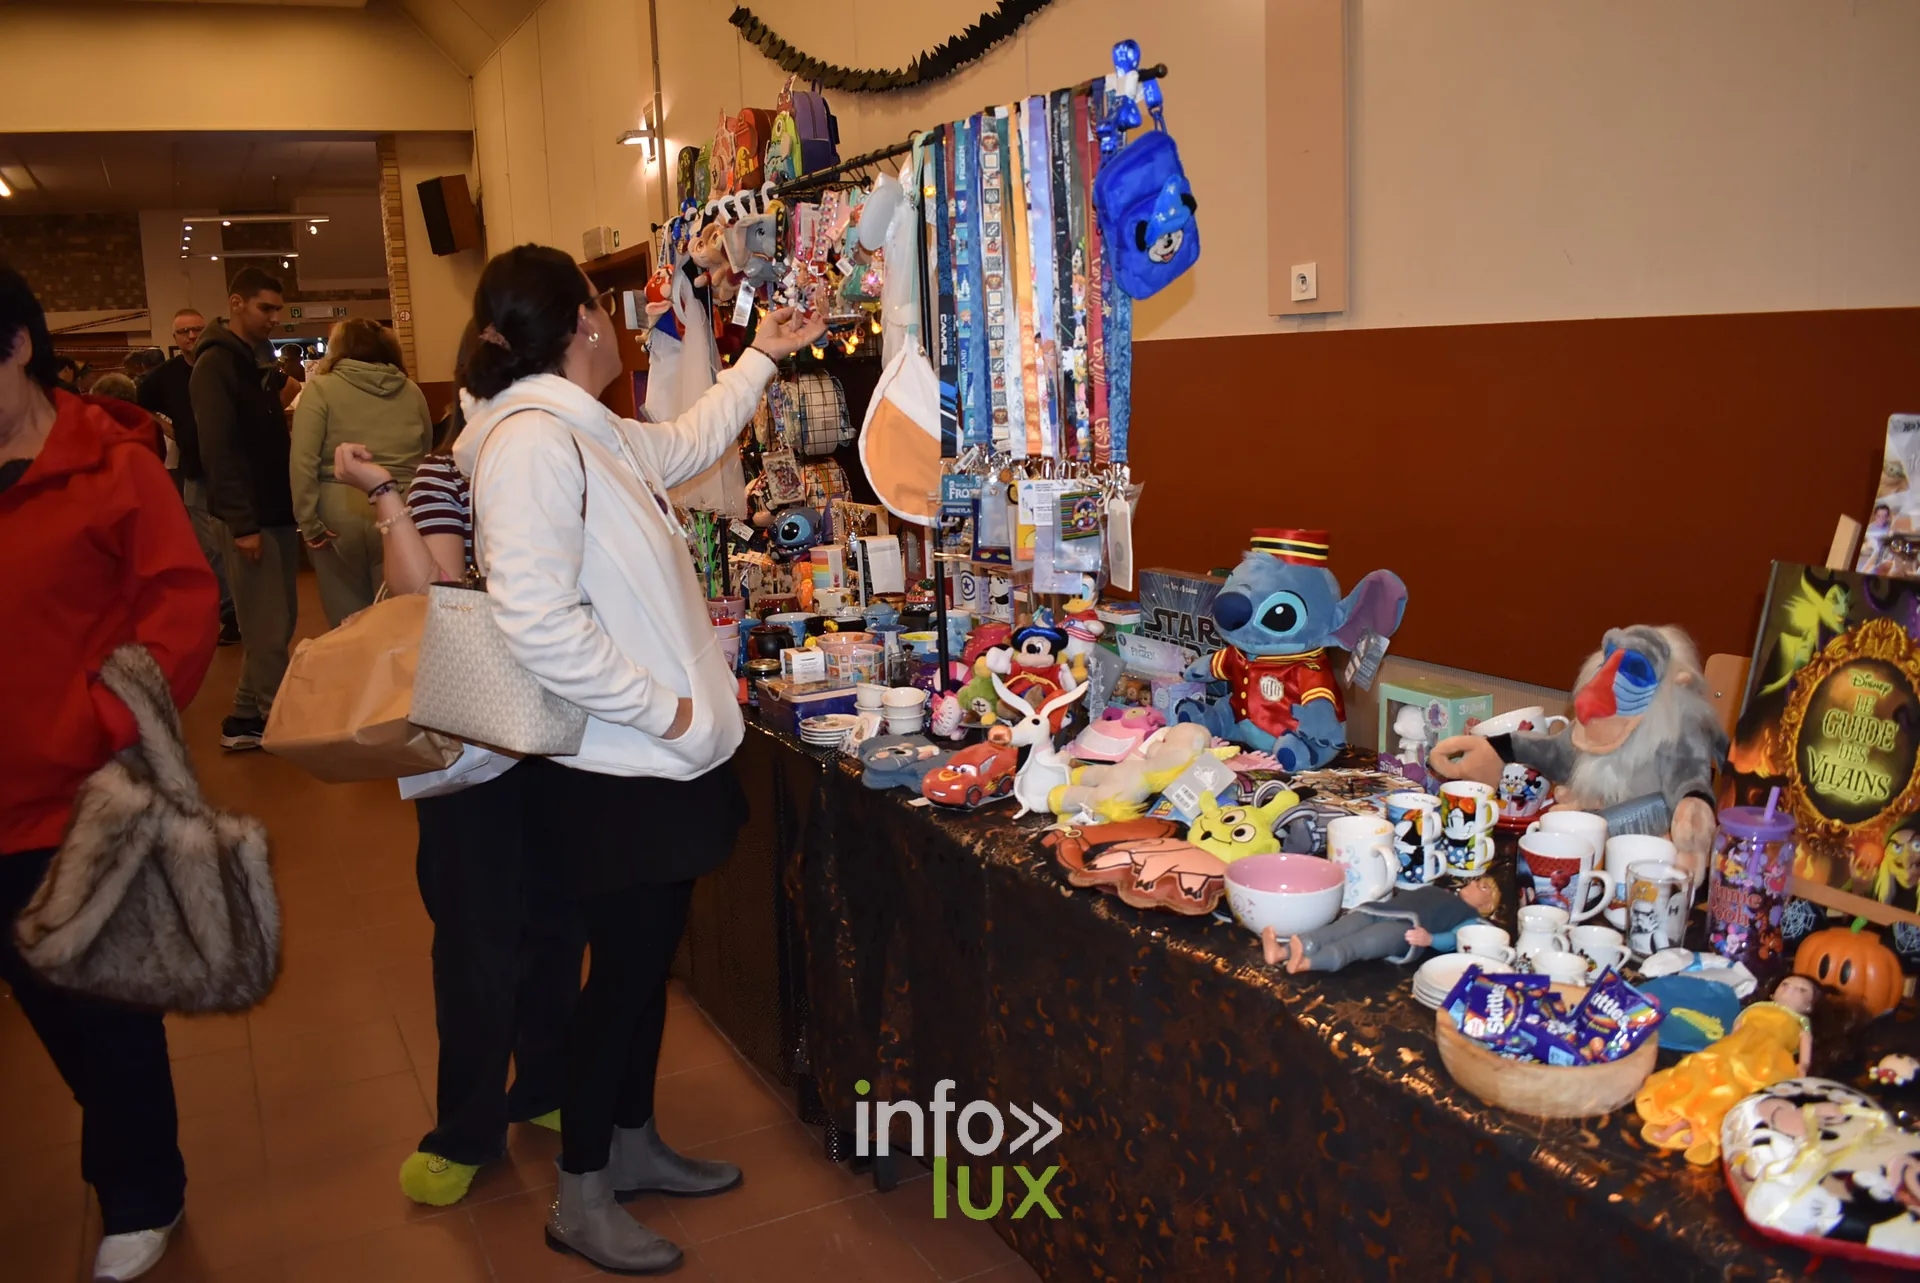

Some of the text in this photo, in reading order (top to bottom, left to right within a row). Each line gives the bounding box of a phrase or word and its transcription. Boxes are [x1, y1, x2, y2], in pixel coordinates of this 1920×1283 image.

[940, 313, 948, 366] CAMPUS
[949, 487, 971, 500] FRO
[1144, 606, 1223, 649] STAR
[1848, 669, 1893, 696] Disney
[1854, 693, 1876, 714] LE
[1823, 708, 1899, 751] GUIDE
[1838, 743, 1870, 765] DES
[1807, 745, 1892, 799] VILAINS
[1712, 905, 1750, 928] ooh
[1486, 983, 1508, 1035] Skittles
